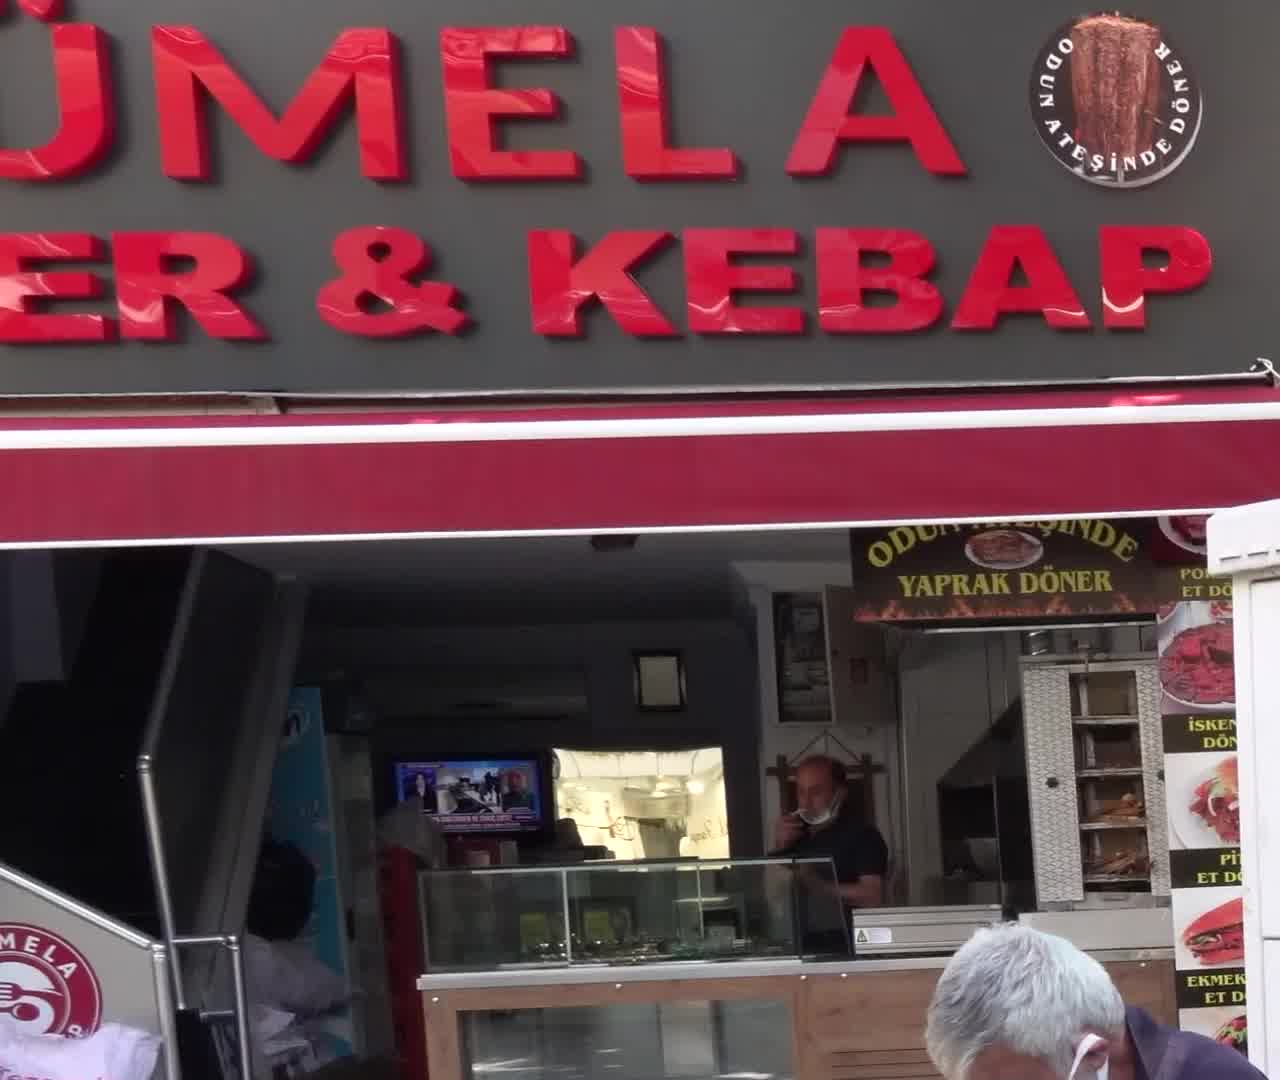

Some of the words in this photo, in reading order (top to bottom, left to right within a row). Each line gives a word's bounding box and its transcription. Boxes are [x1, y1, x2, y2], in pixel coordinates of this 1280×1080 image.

[1039, 38, 1074, 108] ODUN
[1154, 42, 1191, 135] DÖNER
[1044, 119, 1173, 173] ATEŞİNDE
[316, 226, 474, 336] &
[527, 224, 1212, 336] KEBAP
[897, 573, 1012, 597] YAPRAK
[1020, 565, 1113, 594] DÖNER
[1183, 585, 1205, 598] ET
[1197, 872, 1219, 884] ET
[1205, 991, 1227, 1004] ET
